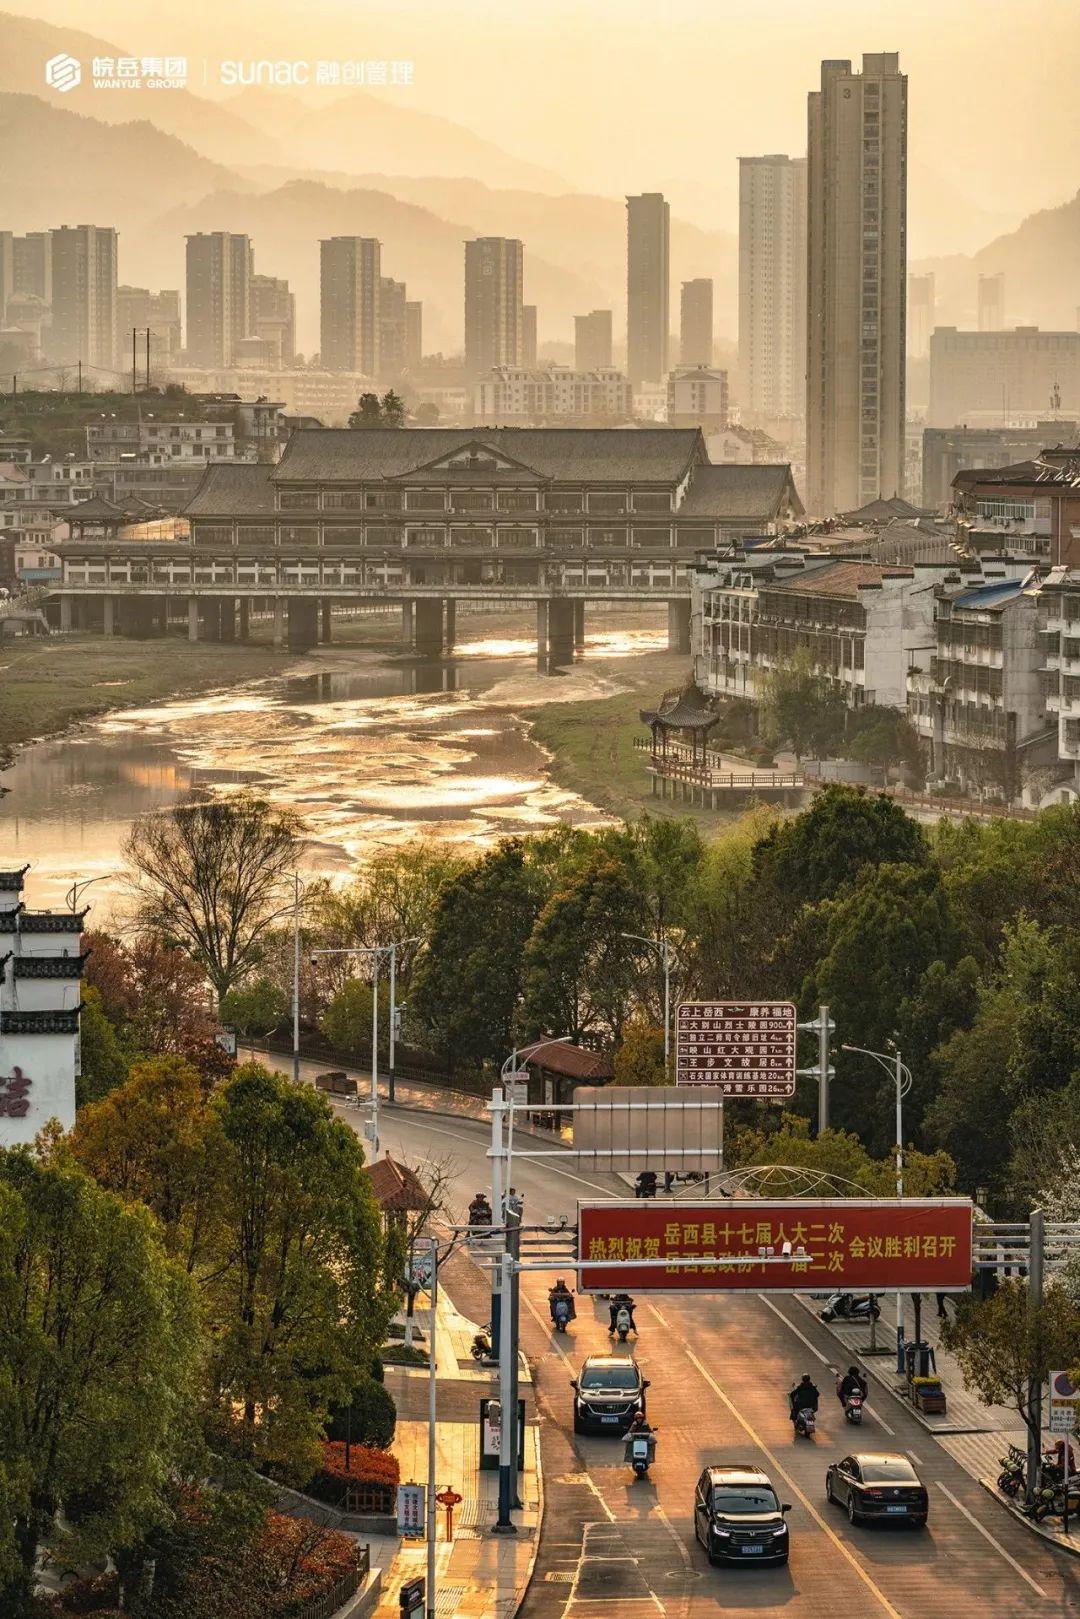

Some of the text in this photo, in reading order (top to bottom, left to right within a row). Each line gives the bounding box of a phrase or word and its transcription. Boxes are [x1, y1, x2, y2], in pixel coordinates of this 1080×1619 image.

[843, 88, 851, 99] 3
[681, 1007, 793, 1017] 云上岳西 康养福地
[689, 1021, 767, 1029] 大别山烈士陵园
[689, 1034, 768, 1042] 独立二师司令部旧址
[689, 1046, 768, 1054] 映山红大观园
[689, 1058, 768, 1067] 王步文故居
[768, 1072, 784, 1080] 20km
[664, 1222, 845, 1245] 岳西县十七届人大二次
[589, 1237, 661, 1260] 热烈祝贺
[849, 1236, 957, 1258] 会议胜利召开
[664, 1251, 845, 1274] 岳西县政协届二次
